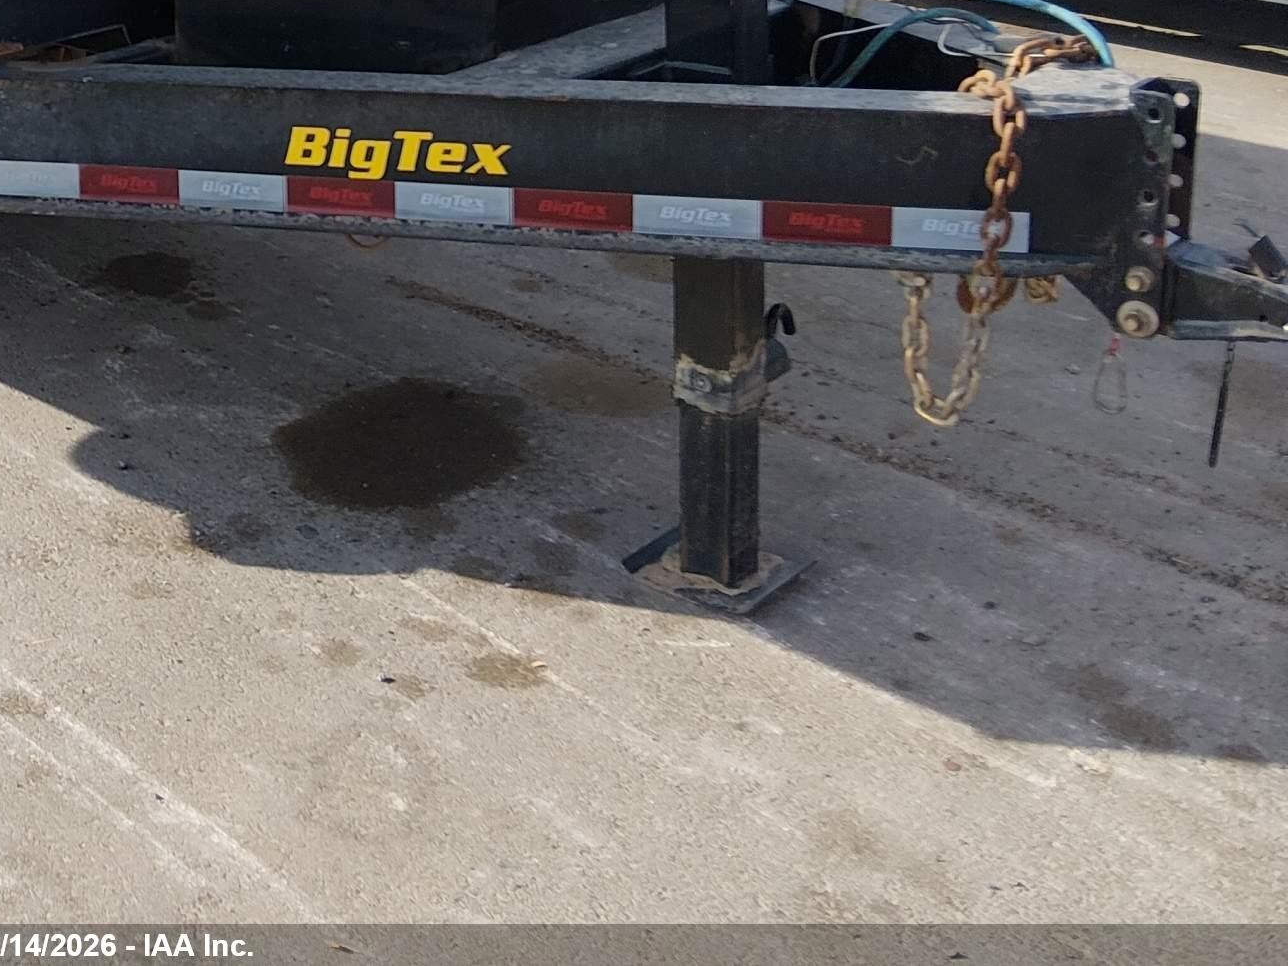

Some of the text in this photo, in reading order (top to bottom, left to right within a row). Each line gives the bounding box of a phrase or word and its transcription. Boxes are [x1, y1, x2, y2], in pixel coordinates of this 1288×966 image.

[284, 126, 512, 181] BigTex
[420, 192, 486, 210] BigTex
[659, 205, 731, 223] BigTex
[789, 211, 864, 229] BigTex
